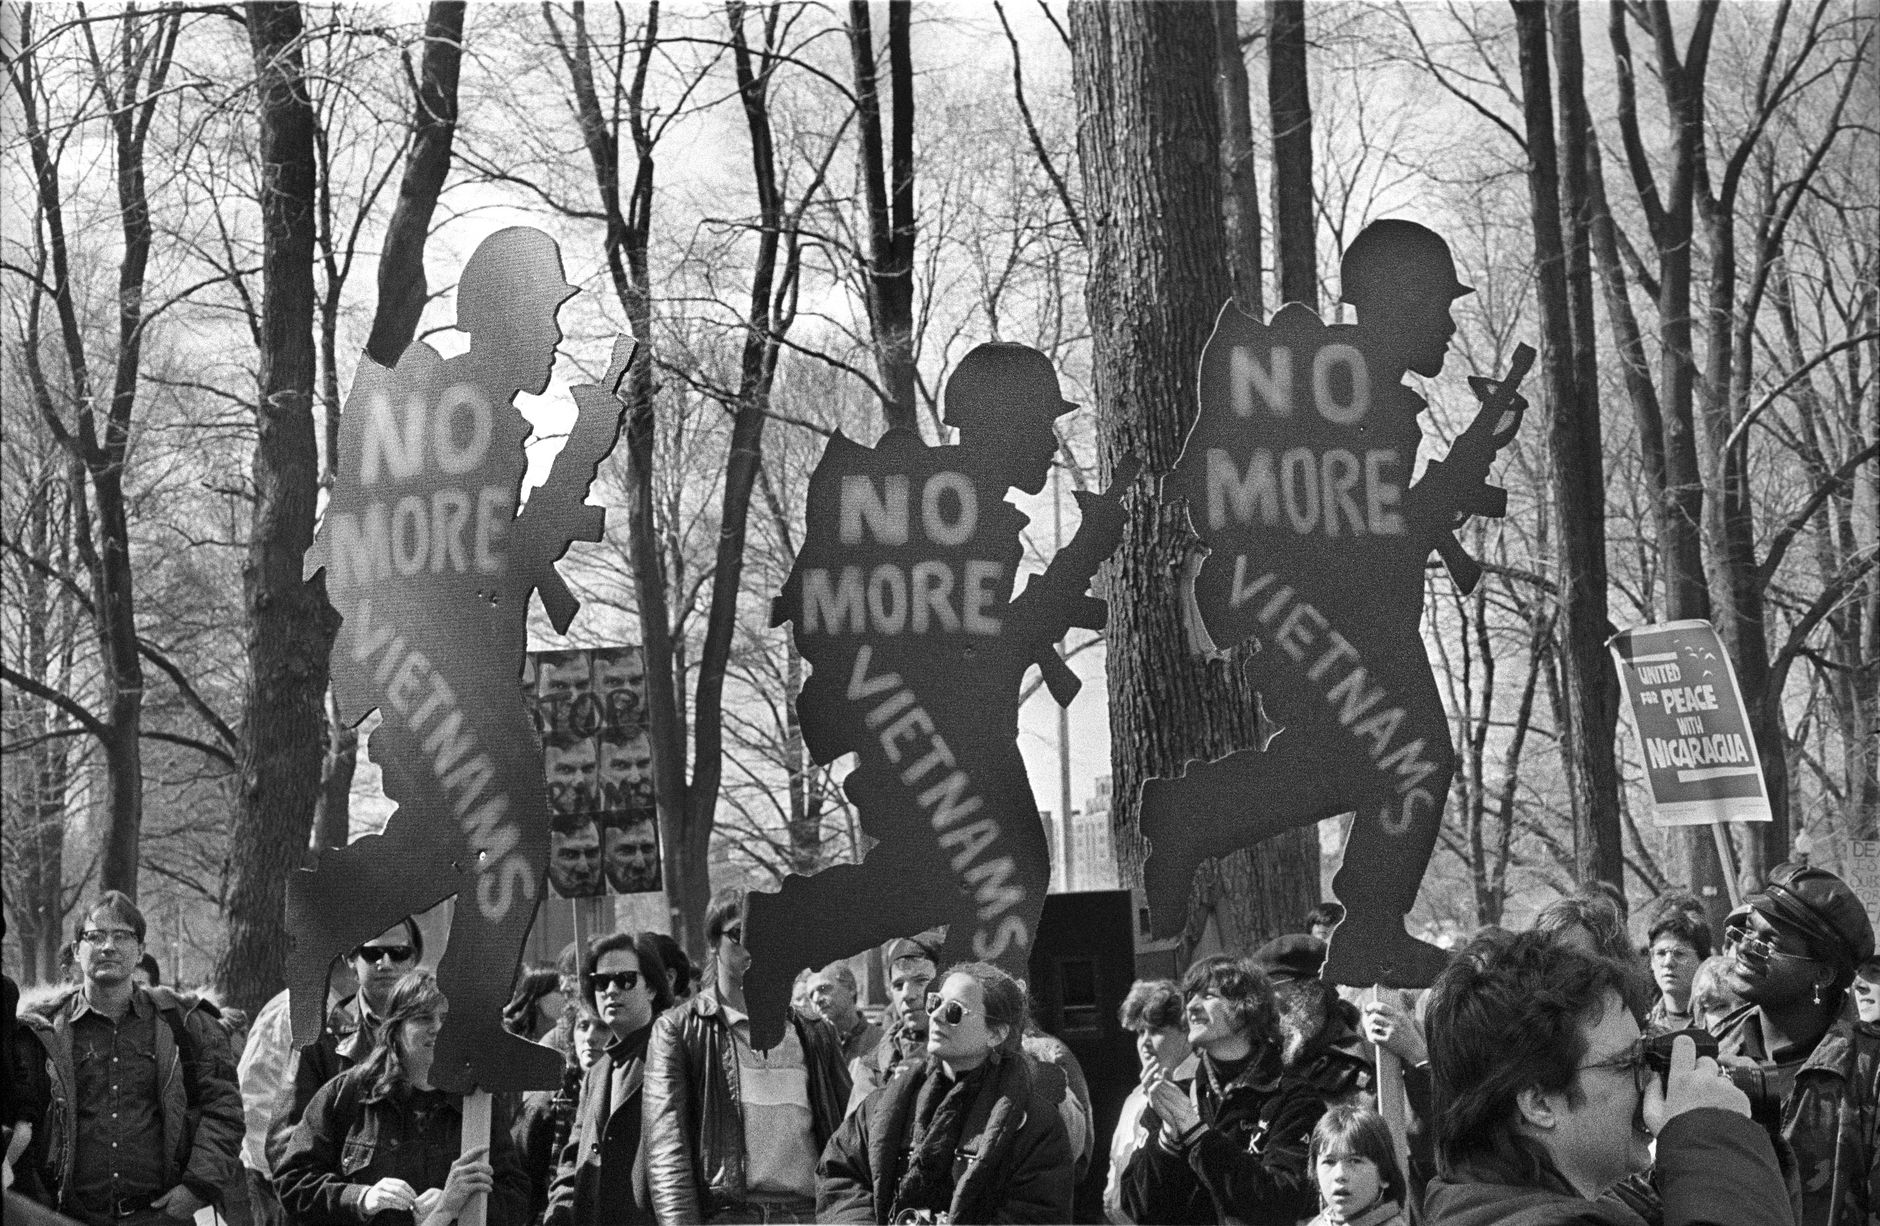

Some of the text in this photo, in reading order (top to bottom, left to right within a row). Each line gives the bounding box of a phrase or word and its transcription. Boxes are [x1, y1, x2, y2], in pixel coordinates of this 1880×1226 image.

[1229, 344, 1371, 424] NO
[360, 382, 494, 486] NO
[839, 471, 979, 546] NO
[1206, 446, 1404, 537] MORE
[329, 486, 511, 585] MORE
[801, 560, 1002, 636] MORE
[1230, 554, 1440, 836] VIETNAMS
[1637, 662, 1682, 686] UNITED
[1640, 684, 1719, 715] FOR PEACE
[350, 598, 536, 924] VIETNAMS
[1646, 733, 1750, 769] NICARAGUA
[1676, 715, 1705, 736] WITH
[847, 644, 1030, 962] VIETNAMS
[1853, 841, 1880, 858] DE
